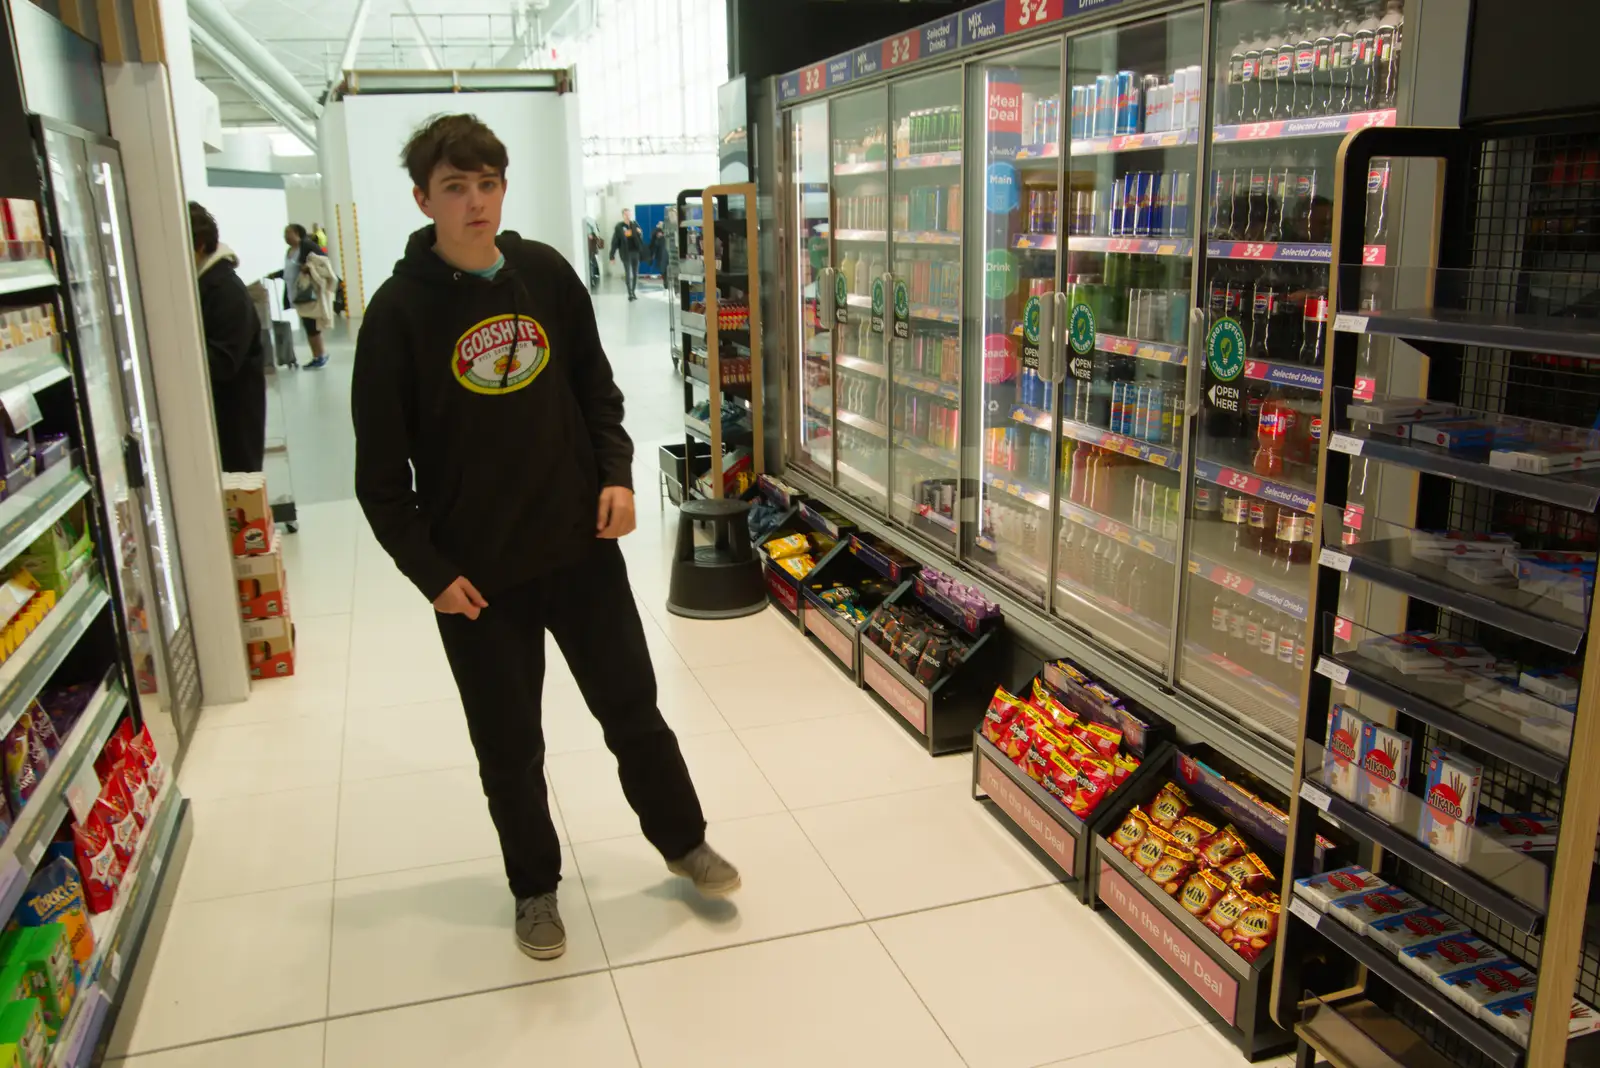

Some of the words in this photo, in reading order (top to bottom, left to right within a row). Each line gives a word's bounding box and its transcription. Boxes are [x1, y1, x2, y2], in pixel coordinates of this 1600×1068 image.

[967, 12, 982, 31] Mix
[926, 23, 951, 40] Selected
[977, 22, 996, 38] Match
[929, 39, 947, 52] Drinks
[990, 94, 1019, 108] Meal
[989, 107, 1018, 122] Deal
[1287, 122, 1318, 132] Selected
[1317, 119, 1340, 130] Drinks
[990, 174, 1012, 185] Main
[1281, 248, 1310, 257] Selected
[1310, 249, 1332, 258] Drinks
[985, 262, 1011, 272] Drink
[460, 320, 539, 361] GOBSHITE
[1208, 323, 1224, 357] ENERGY
[1224, 321, 1244, 362] EFFICIENT
[1075, 357, 1092, 369] OPEN
[1211, 360, 1239, 377] CHILLERS
[1075, 367, 1092, 379] HERE
[1271, 368, 1300, 382] Selected
[1299, 372, 1323, 385] Drinks
[1216, 385, 1240, 399] OPEN
[1216, 398, 1239, 411] HERE
[1264, 486, 1292, 501] Selected
[1256, 588, 1284, 606] Selected
[1283, 599, 1304, 614] Drinks
[1331, 736, 1356, 761] MIKADO
[1364, 757, 1396, 781] MIKADO
[1428, 790, 1463, 819] MIKADO
[1000, 786, 1008, 800] in
[1008, 791, 1022, 813] the
[1023, 805, 1044, 833] Meal
[1044, 825, 1065, 855] Deal
[1109, 880, 1126, 906] I'm
[1128, 898, 1139, 919] in
[1141, 911, 1160, 937] the
[1163, 930, 1191, 968] Meal
[1193, 959, 1223, 998] Deal
